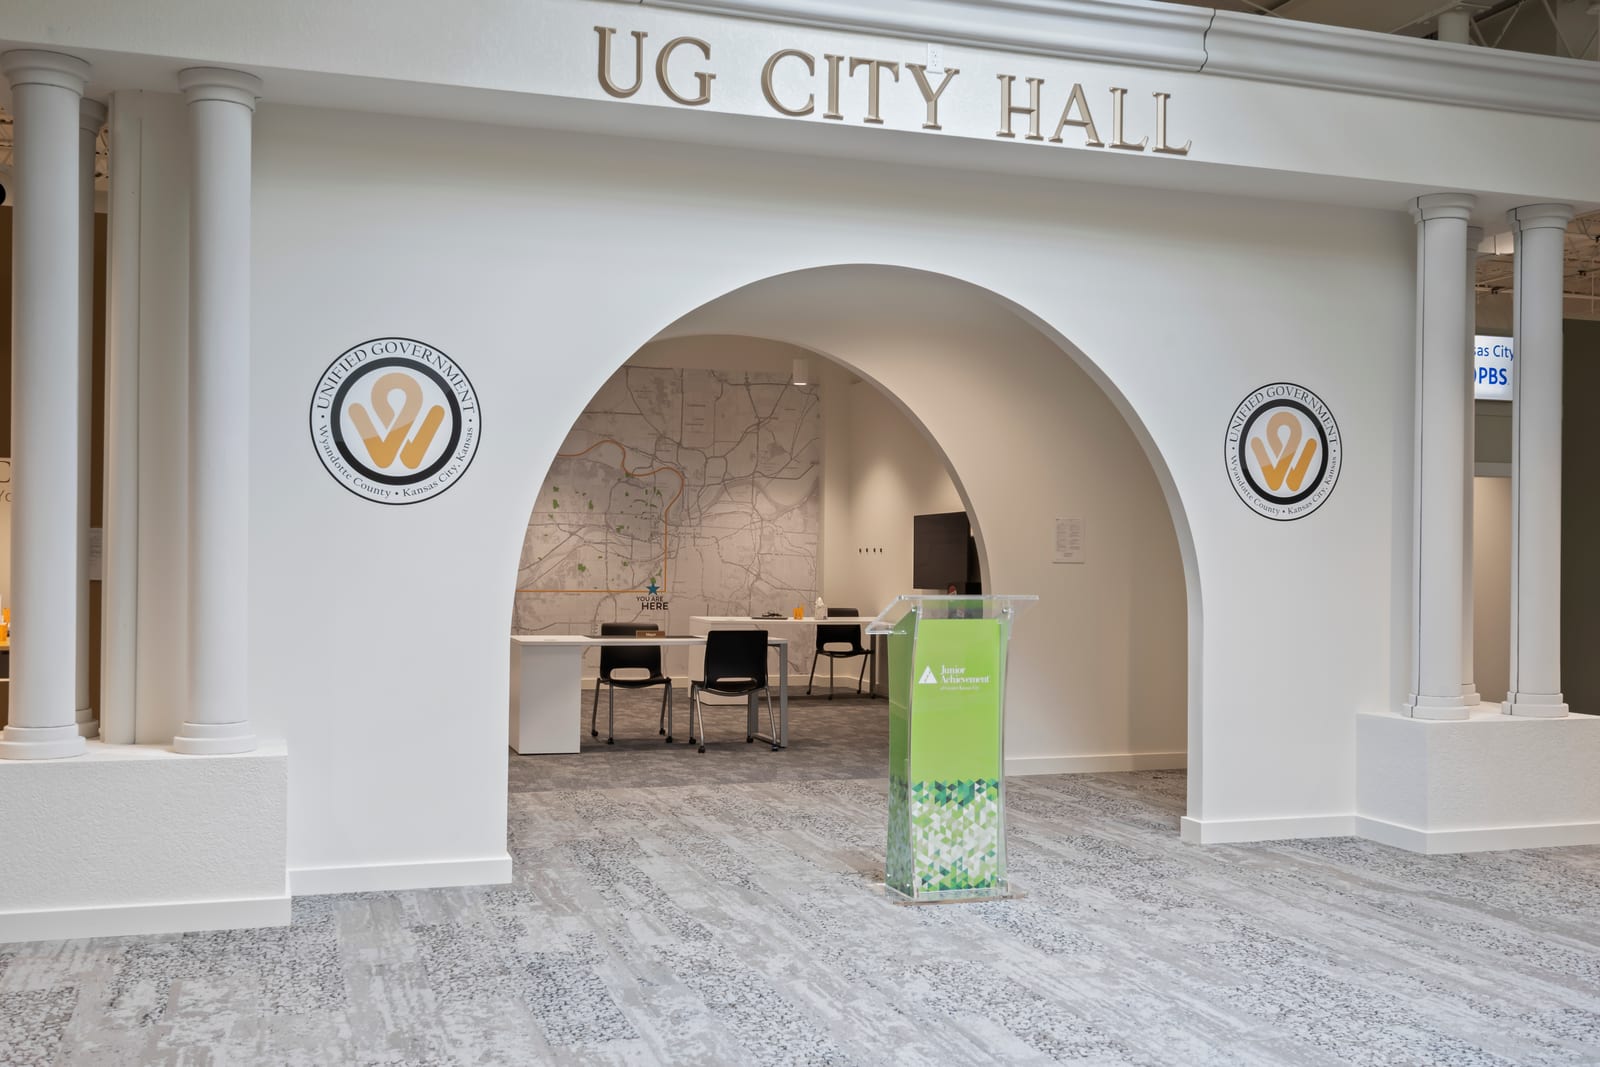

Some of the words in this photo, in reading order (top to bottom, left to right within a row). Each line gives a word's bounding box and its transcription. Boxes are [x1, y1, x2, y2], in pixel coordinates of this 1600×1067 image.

[593, 26, 717, 106] UG
[760, 48, 960, 131] CITY
[996, 73, 1193, 156] HALL
[317, 349, 367, 410] UNIFIED
[371, 341, 475, 413] GOVERNMENT
[1229, 392, 1265, 443] UNIFIED
[1266, 386, 1338, 445] GOVERNMENT
[319, 424, 352, 479] Wyandotte
[353, 477, 391, 499] County
[402, 480, 439, 497] Kansas
[438, 463, 461, 483] City,
[456, 427, 474, 462] Kansas
[1230, 455, 1254, 498] Wyandotte
[1253, 496, 1281, 515] County
[1287, 501, 1313, 515] Kansas
[1323, 456, 1337, 485] Kansas
[641, 602, 669, 611] HERE
[940, 664, 966, 675] Junior
